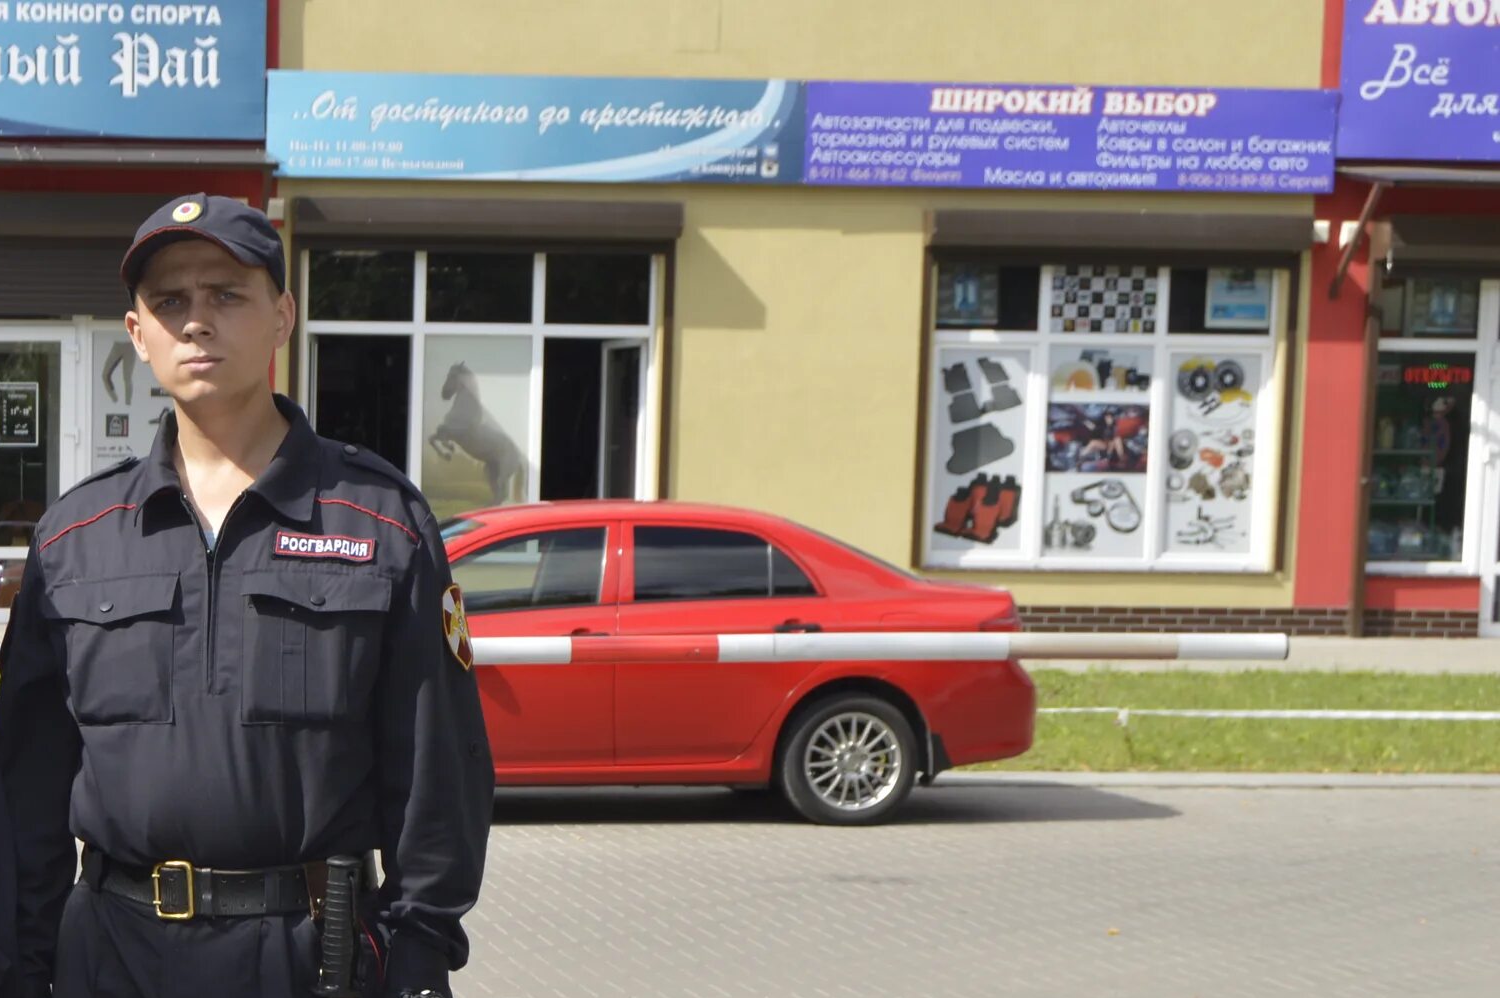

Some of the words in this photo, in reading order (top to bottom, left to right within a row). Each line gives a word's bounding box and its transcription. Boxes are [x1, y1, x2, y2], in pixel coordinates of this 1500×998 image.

[16, 2, 124, 24] КОННОГО
[131, 4, 222, 26] СПОРТА
[109, 32, 221, 97] Рай
[1360, 43, 1450, 100] Всё
[929, 85, 1094, 115] ШИРОКИЙ
[1103, 91, 1217, 117] ВЫБОР
[1429, 93, 1499, 118] для
[370, 98, 529, 133] доступного
[538, 103, 570, 135] до
[811, 112, 931, 132] Автозапчасти
[934, 118, 965, 134] для
[969, 119, 1057, 135] подвески,
[1098, 117, 1187, 135] Авточехлы
[811, 131, 907, 149] тормозной
[911, 134, 923, 148] и
[928, 134, 999, 151] рулевых
[1004, 136, 1070, 151] систем
[1097, 134, 1152, 153] Ковры
[1157, 138, 1167, 151] в
[1172, 138, 1227, 152] салон
[1231, 139, 1243, 152] и
[1248, 136, 1332, 155] багажник
[810, 147, 961, 168] Автоаксессуары
[1096, 151, 1172, 171] Фильтры
[1176, 155, 1198, 169] на
[1204, 155, 1264, 170] любое
[1268, 156, 1308, 171] авто
[984, 167, 1045, 185] Масла
[1049, 172, 1062, 185] и
[1066, 171, 1157, 189] автохимия
[281, 535, 368, 557] РОСГВАРДИЯ
